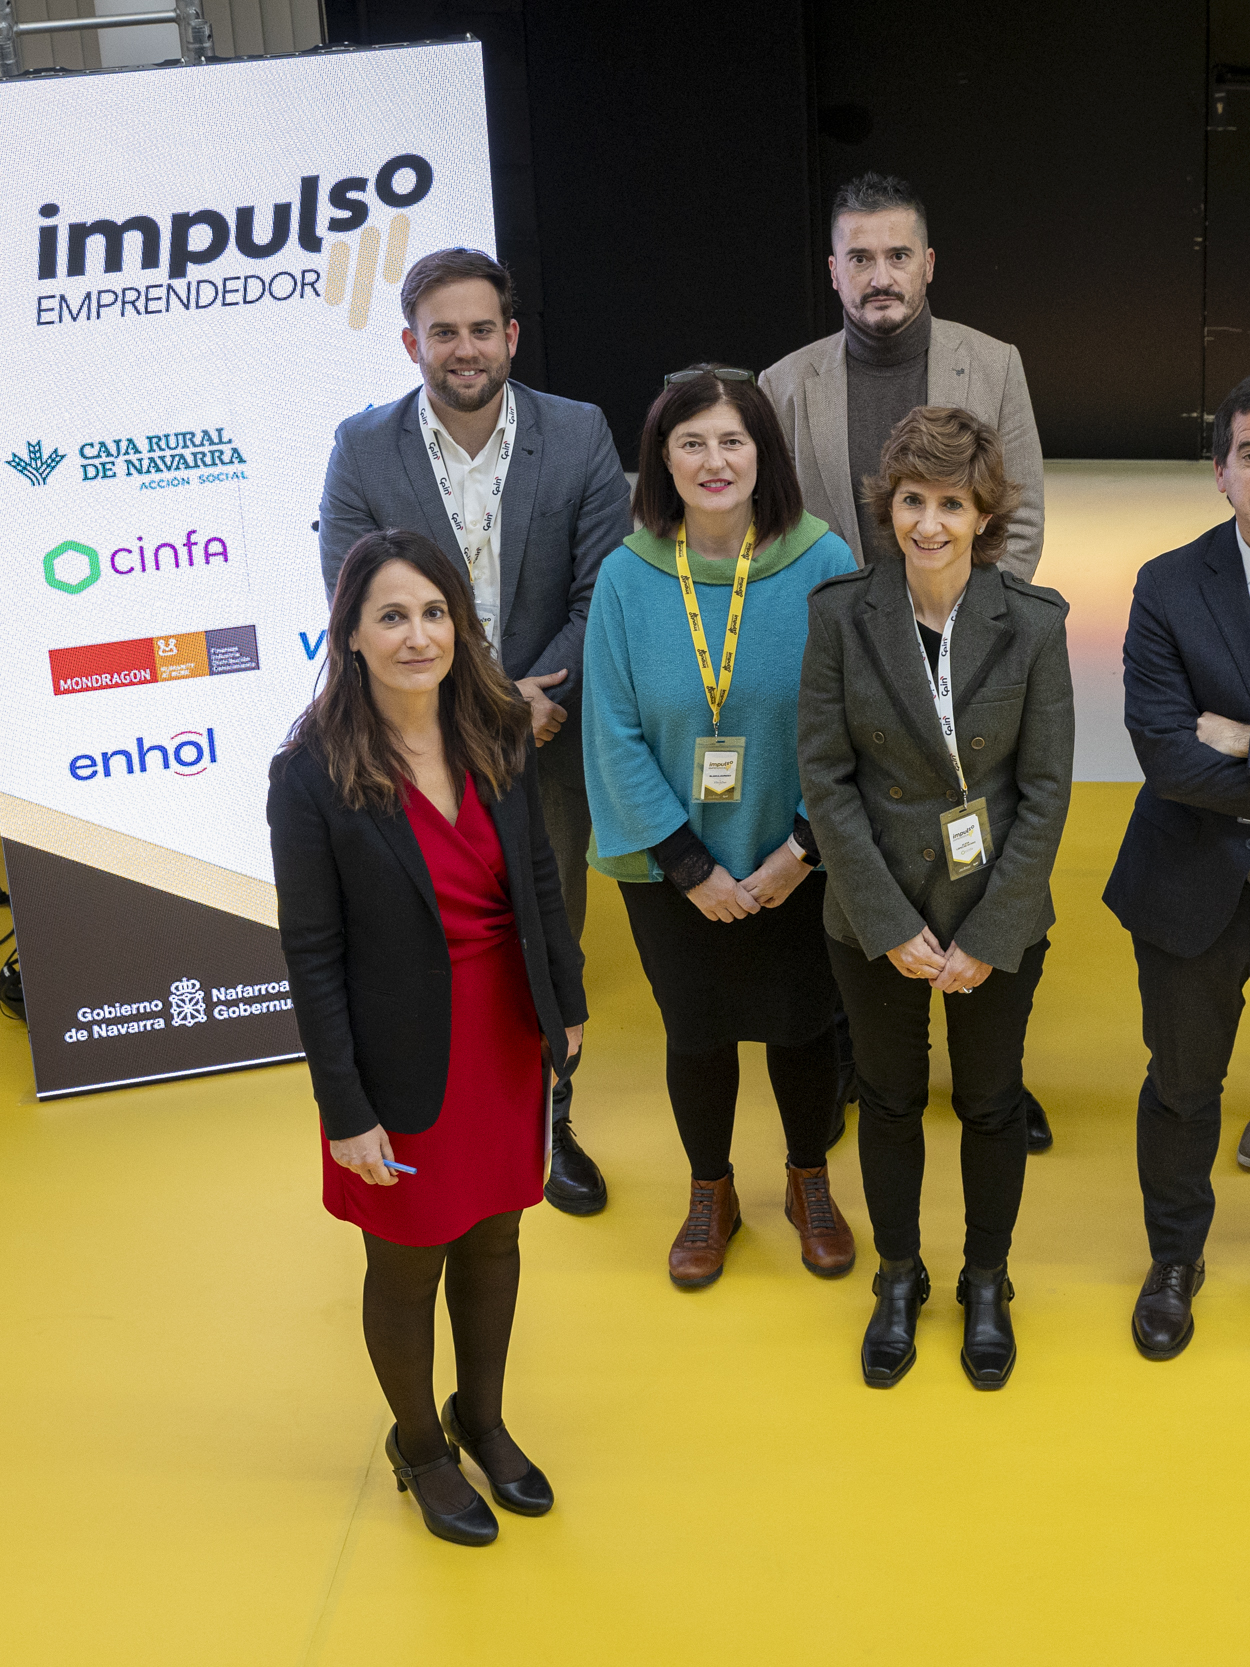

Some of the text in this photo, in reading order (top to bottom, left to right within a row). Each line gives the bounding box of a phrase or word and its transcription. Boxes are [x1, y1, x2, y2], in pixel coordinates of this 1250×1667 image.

[38, 153, 434, 280] impulso
[37, 269, 321, 326] EMPRENDEDOR
[79, 427, 233, 459] CAJA RURAL
[428, 442, 438, 460] Gain
[500, 442, 510, 460] Gain
[80, 447, 247, 481] DE NAVARRA
[198, 470, 248, 484] SOCIAL
[439, 477, 449, 495] Gain
[492, 478, 502, 496] Gain
[451, 512, 462, 530] Gain
[482, 514, 493, 531] Gain
[59, 668, 151, 691] MONDRAGON
[940, 677, 950, 697] Gain
[943, 717, 953, 736] Gain
[69, 727, 217, 781] enhol
[211, 980, 290, 1002] Nafarroa
[77, 1000, 163, 1022] Gobierno
[212, 998, 293, 1021] Gobernu
[63, 1018, 165, 1043] de Navarra
